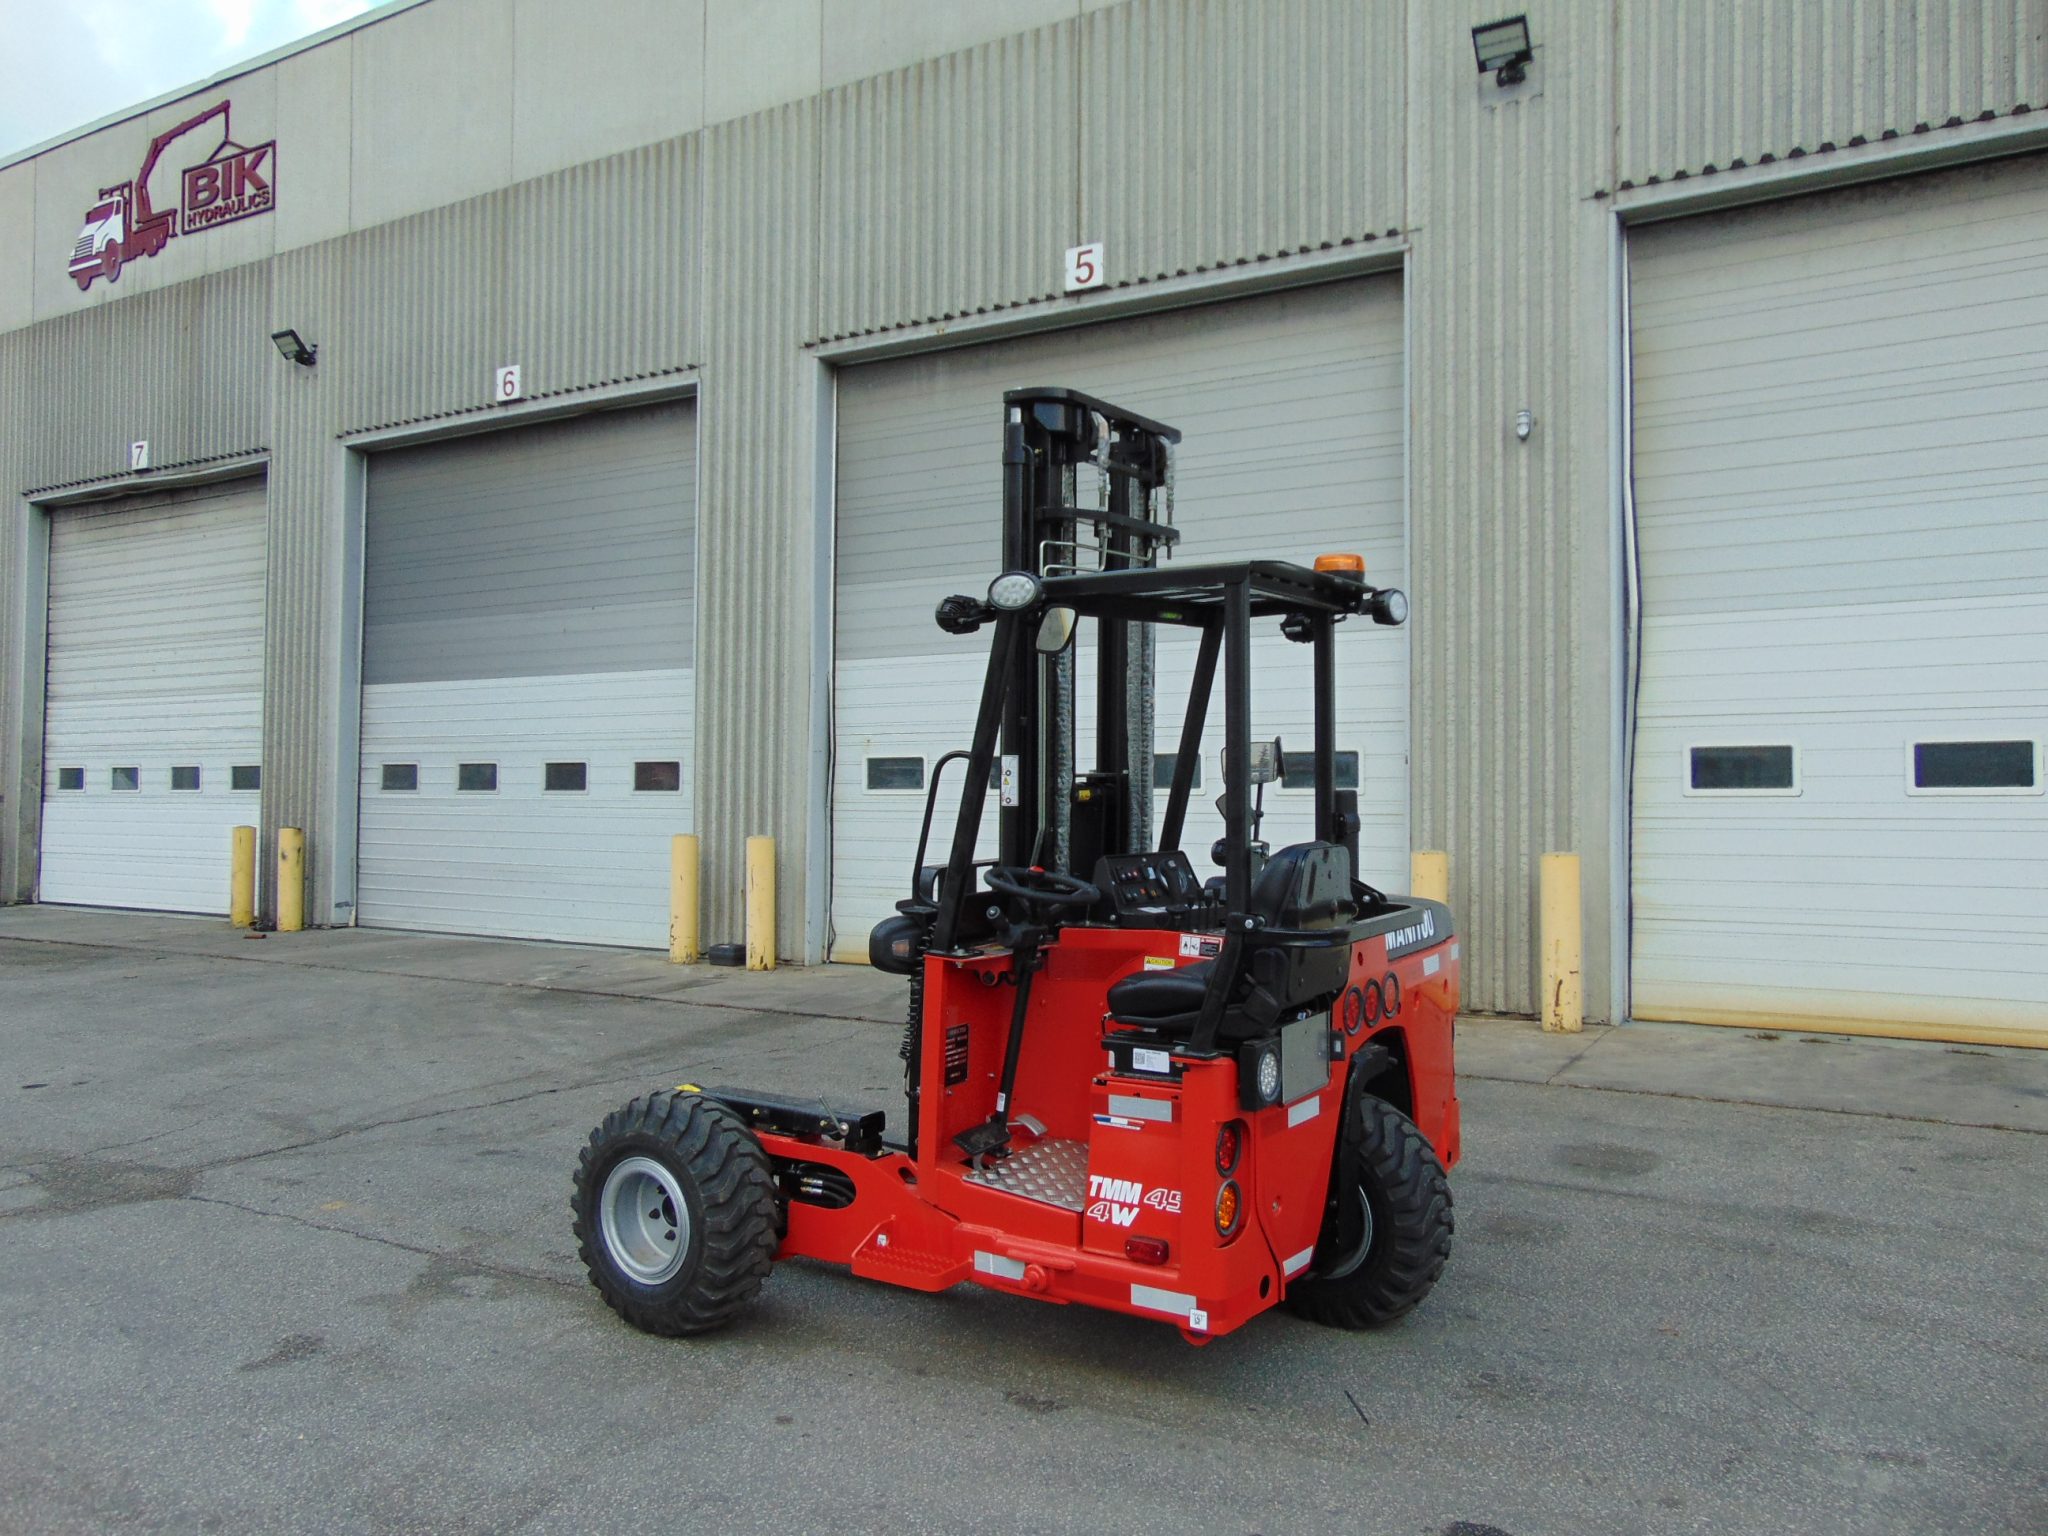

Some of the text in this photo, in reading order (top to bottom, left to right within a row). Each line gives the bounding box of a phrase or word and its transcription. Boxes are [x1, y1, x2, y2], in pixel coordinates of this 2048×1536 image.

[187, 149, 268, 211] BIK
[187, 189, 270, 228] HYDRAULICS
[1075, 248, 1094, 284] 5
[503, 370, 515, 397] 6
[135, 444, 144, 466] 7
[1384, 908, 1435, 951] MANITOU
[1089, 1174, 1182, 1213] TMM 45
[1086, 1201, 1140, 1227] 4W
